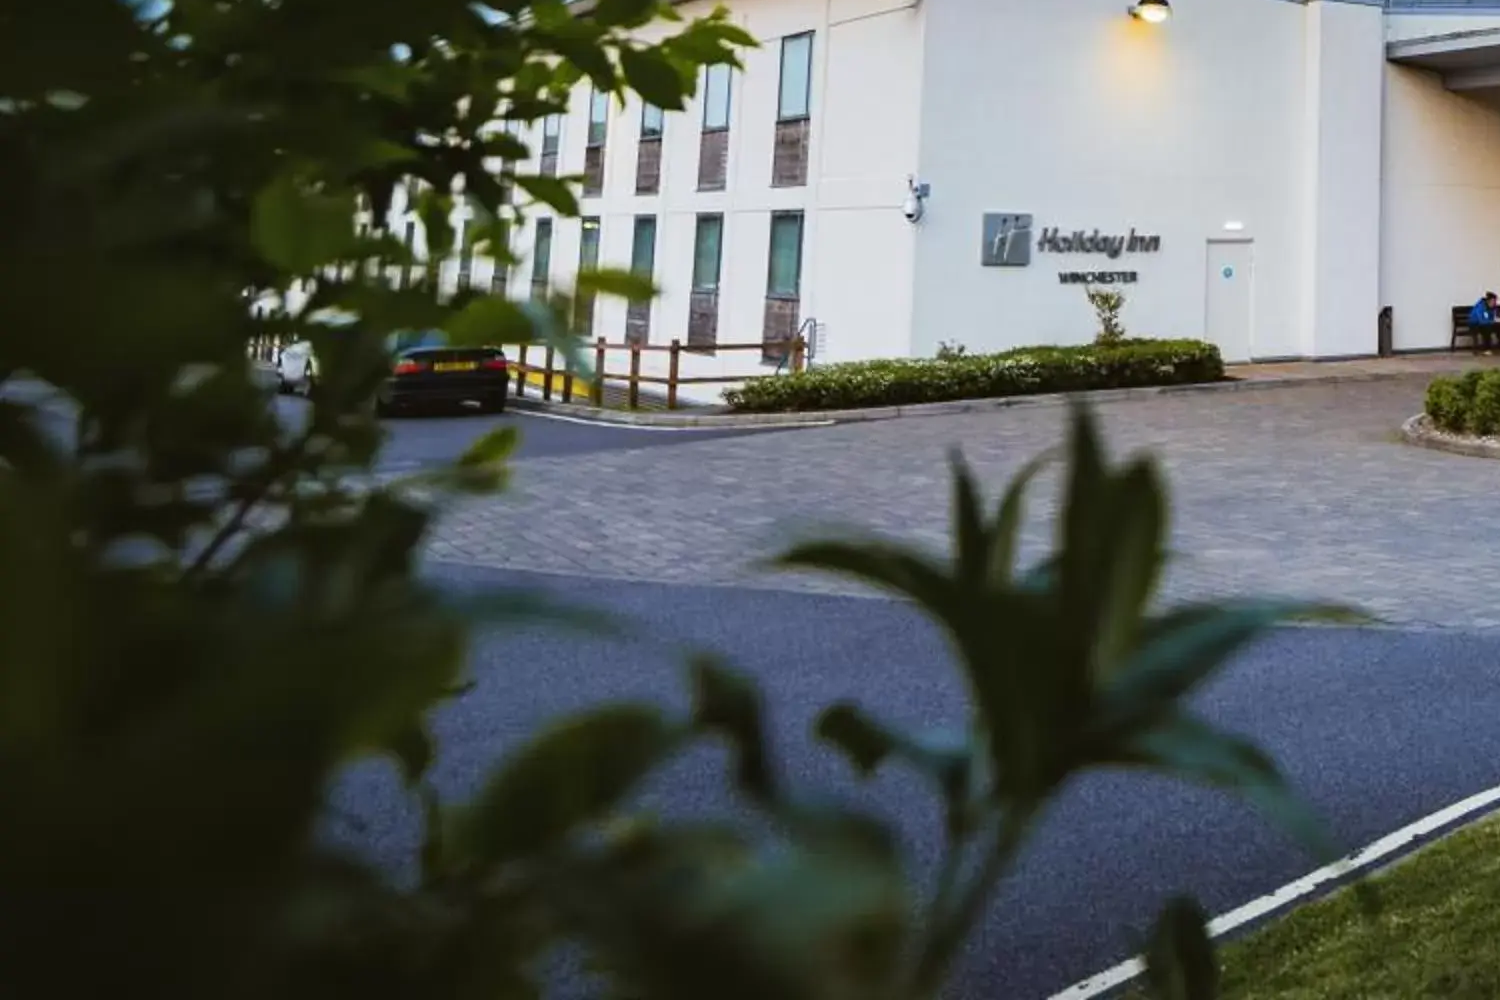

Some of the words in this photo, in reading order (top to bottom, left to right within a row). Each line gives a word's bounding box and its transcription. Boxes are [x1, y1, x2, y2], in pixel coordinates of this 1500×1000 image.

[1037, 227, 1124, 259] Holiday
[1126, 227, 1161, 252] Inn
[1058, 271, 1138, 285] WINCHESTER
